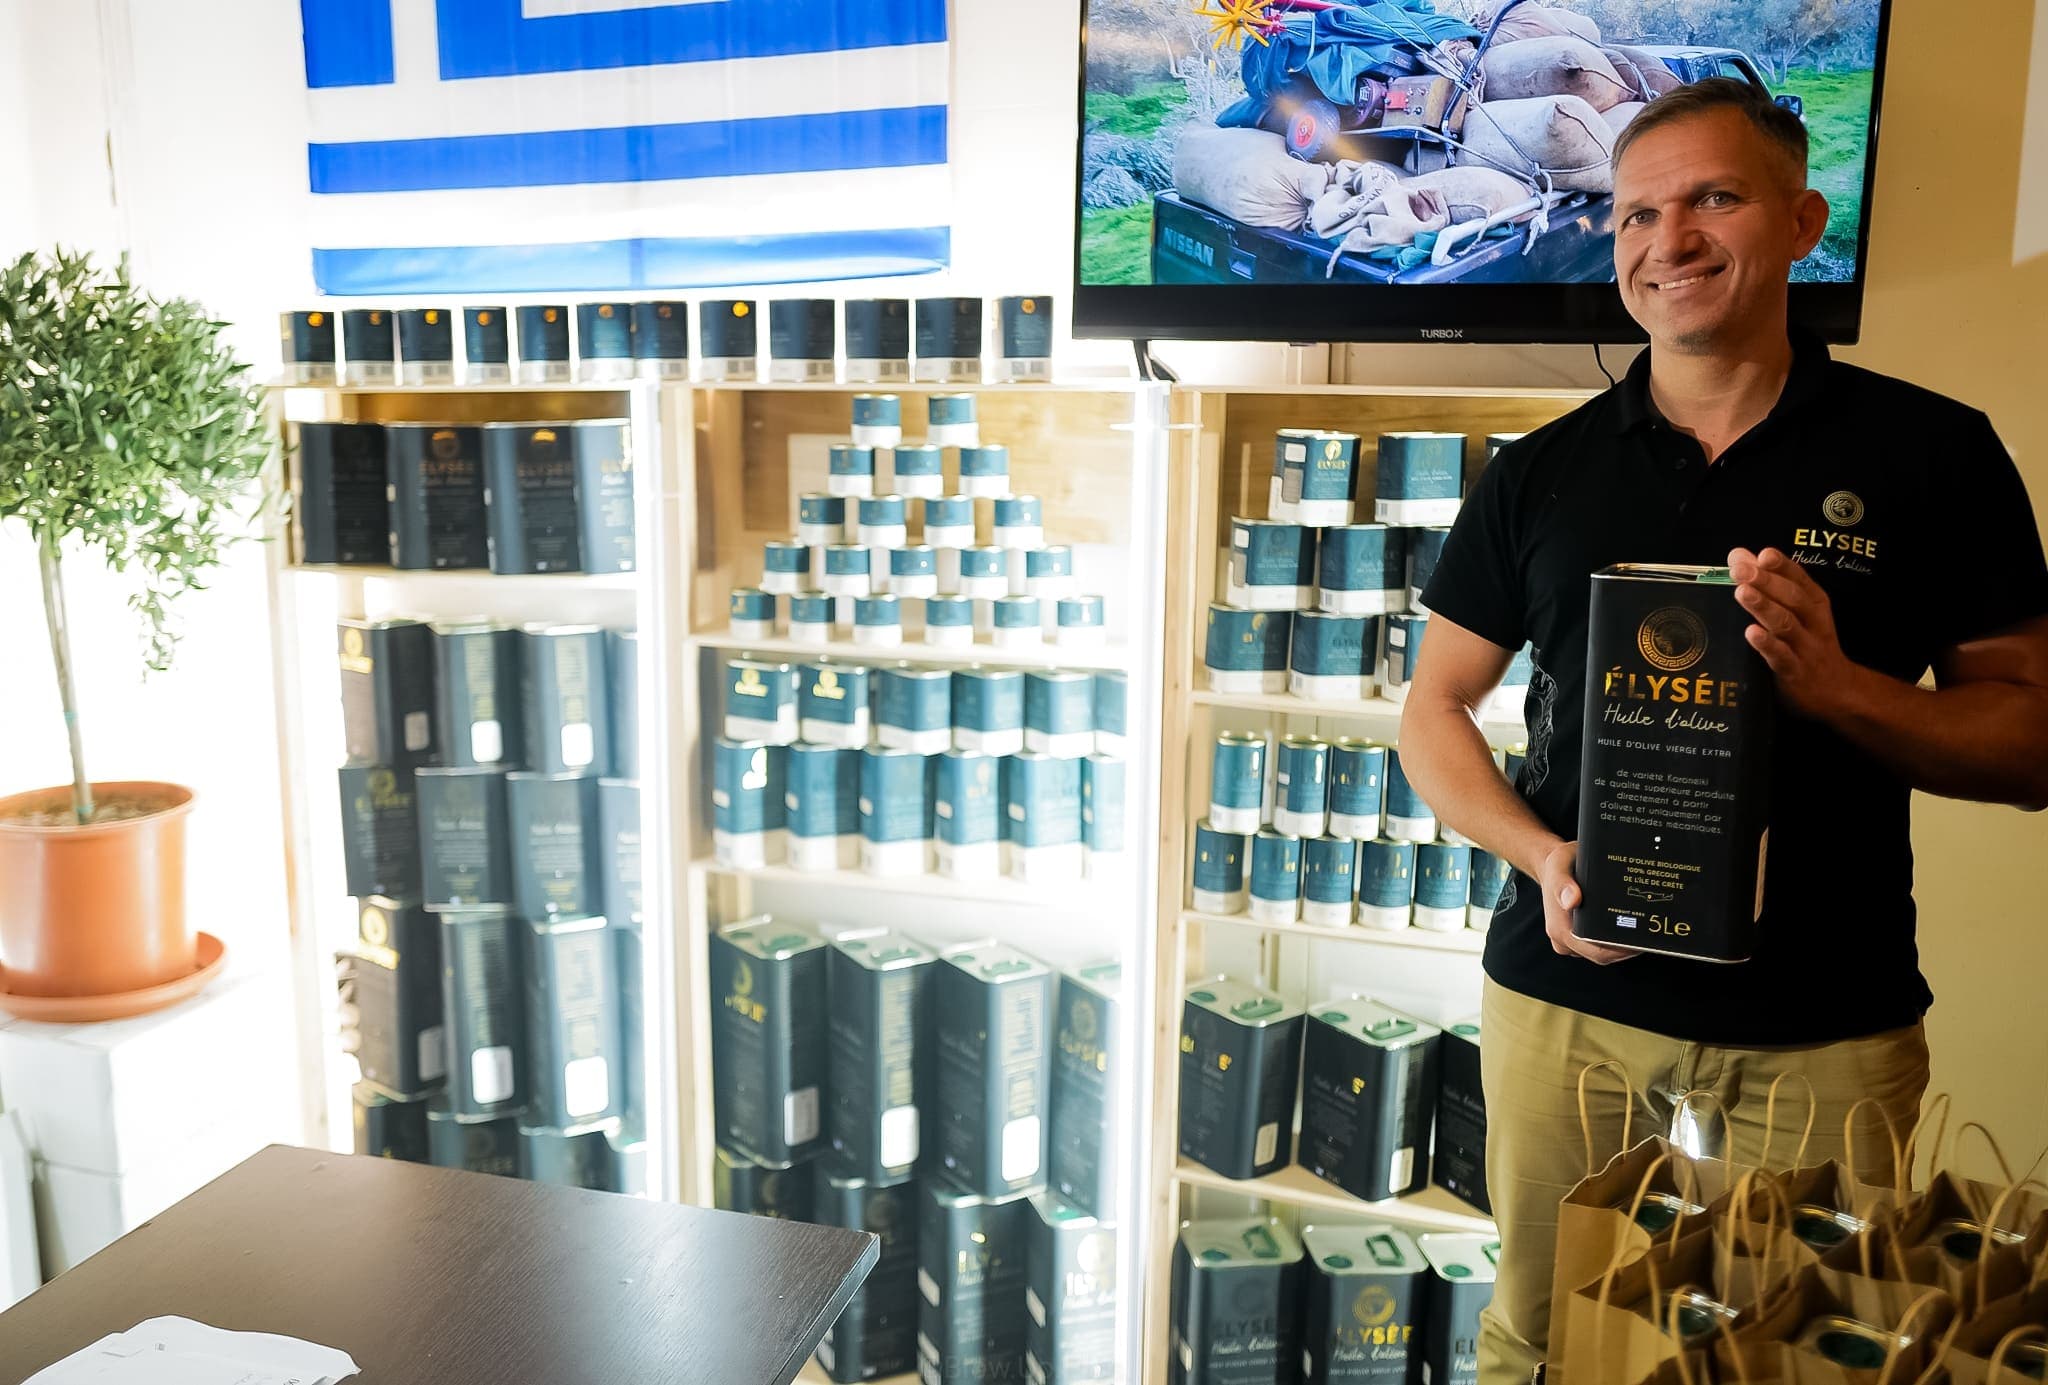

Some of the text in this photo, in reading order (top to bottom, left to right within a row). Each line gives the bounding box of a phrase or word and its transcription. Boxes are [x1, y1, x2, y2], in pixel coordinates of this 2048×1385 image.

[1163, 226, 1215, 268] NISSAN
[1794, 528, 1878, 559] ELYSEE
[1604, 665, 1739, 707] ÉLYSÉE
[1603, 703, 1729, 732] Huile d'olive
[1597, 738, 1732, 758] HUILE D'OLIVE VIERGE EXTRA
[1594, 777, 1606, 786] de
[1616, 769, 1629, 778] de
[1616, 792, 1669, 805] directement
[1683, 800, 1709, 809] partir
[1600, 812, 1617, 821] des
[1636, 805, 1646, 813] et
[1649, 807, 1701, 820] uniquement
[1704, 813, 1722, 823] par
[1607, 854, 1701, 872] HUILE D'OLIVE BIOLOGIQUE
[1627, 866, 1646, 875] 100%
[1650, 879, 1660, 887] DE
